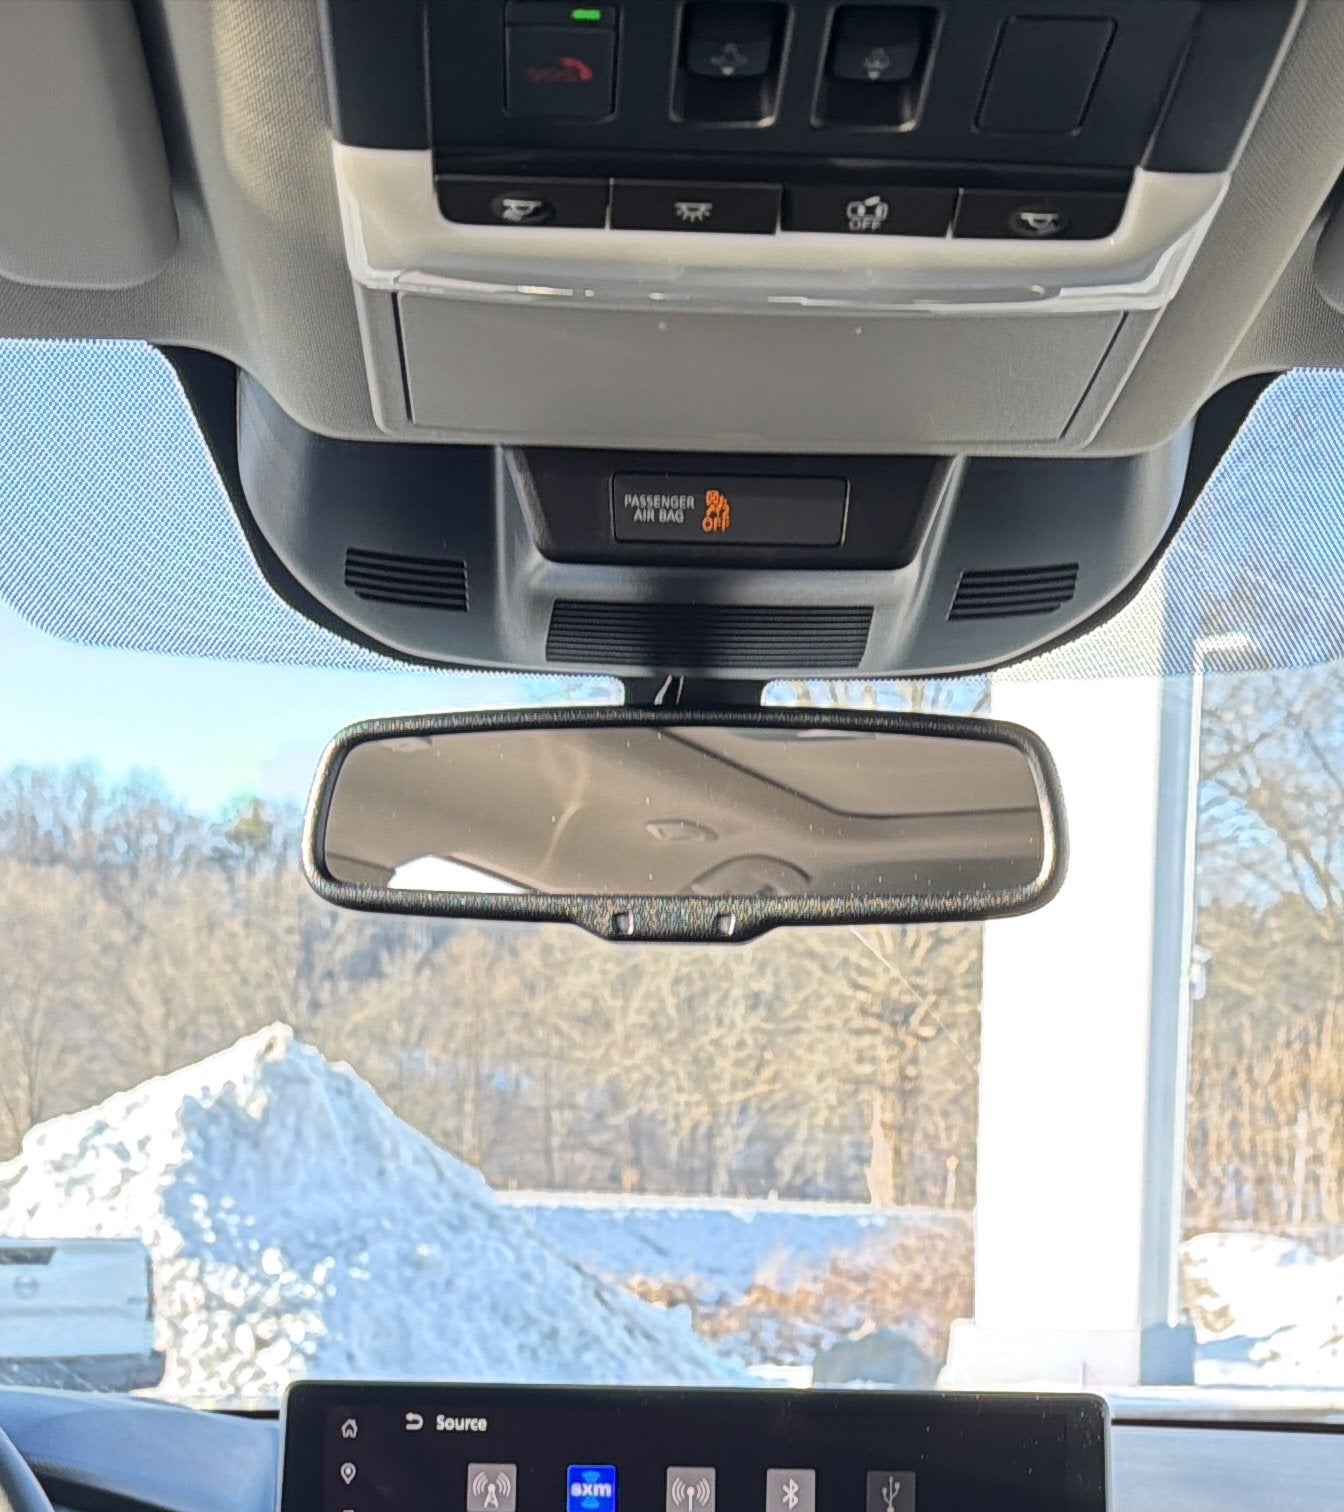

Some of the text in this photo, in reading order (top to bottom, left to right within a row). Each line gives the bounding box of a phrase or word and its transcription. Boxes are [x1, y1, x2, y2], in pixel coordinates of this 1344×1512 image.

[624, 494, 694, 509] PASSENGER
[634, 508, 684, 523] AIR BAG
[436, 1415, 487, 1431] Source
[570, 1482, 612, 1498] sxm
